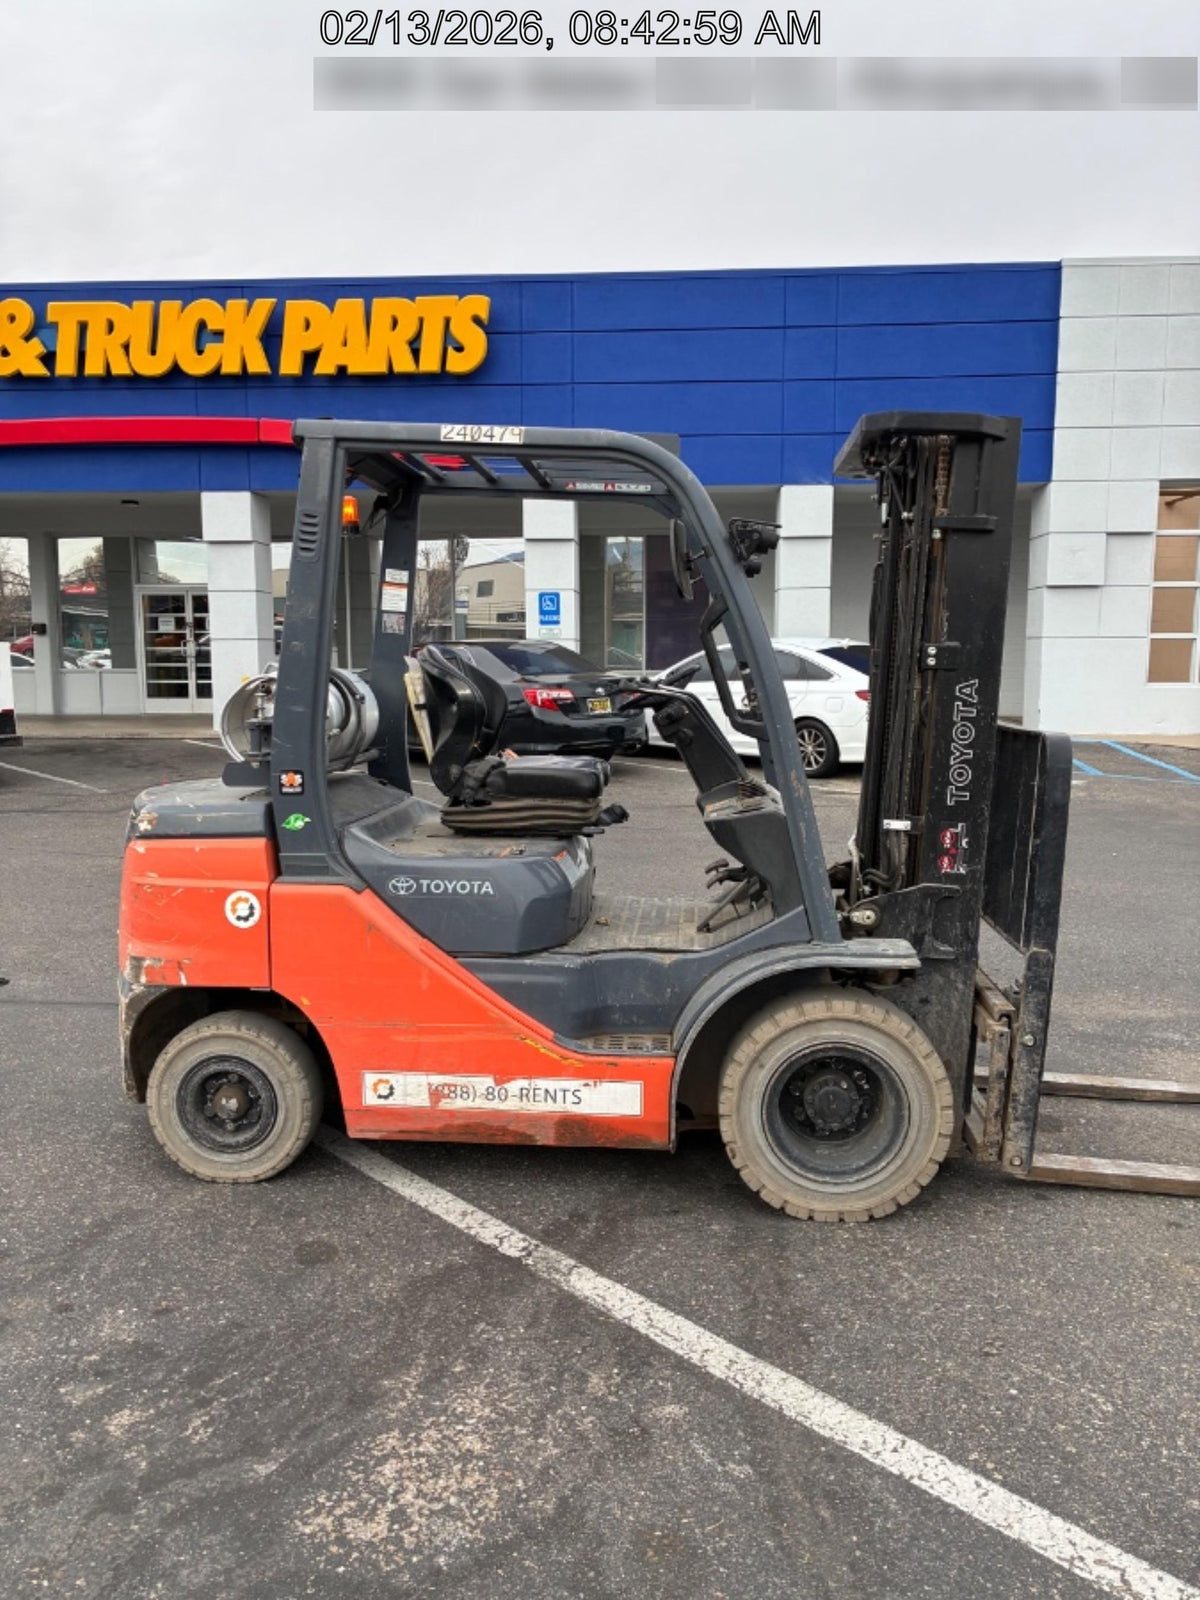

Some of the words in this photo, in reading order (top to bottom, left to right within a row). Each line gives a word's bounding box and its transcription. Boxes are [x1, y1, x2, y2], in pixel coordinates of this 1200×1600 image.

[0, 297, 51, 377] &
[47, 297, 278, 378] TRUCK
[279, 294, 492, 376] PARTS
[947, 678, 980, 806] TOYOTA
[419, 879, 494, 895] TOYOTA
